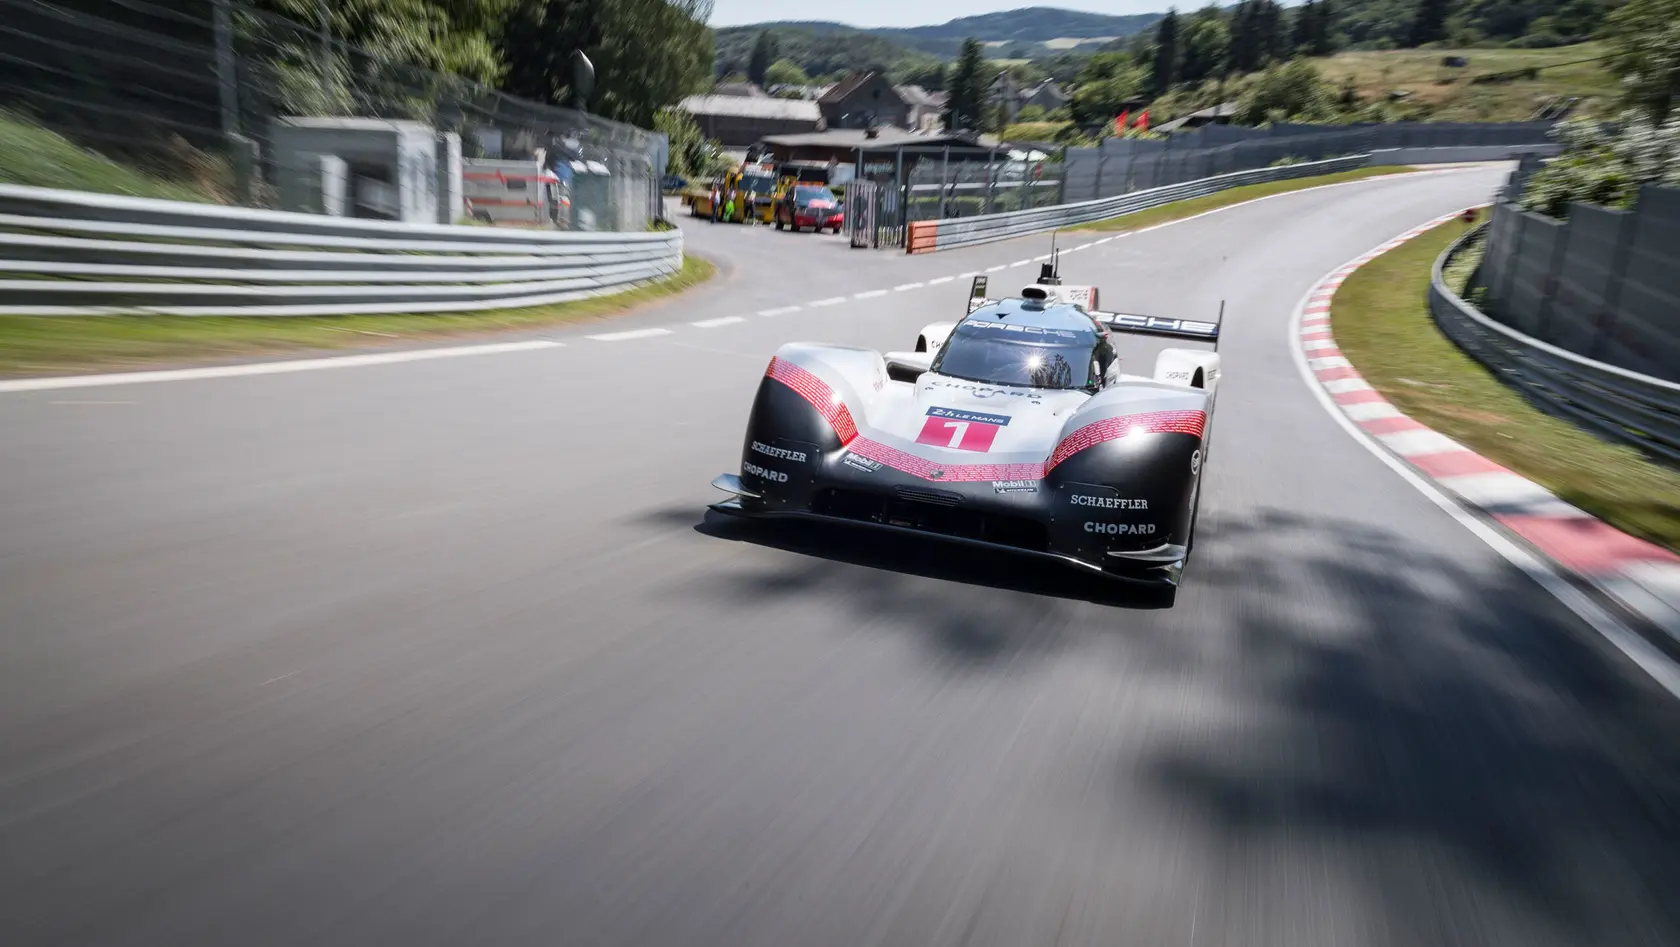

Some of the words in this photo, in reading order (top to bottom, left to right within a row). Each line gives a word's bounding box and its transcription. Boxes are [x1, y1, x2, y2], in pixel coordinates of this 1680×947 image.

[963, 320, 1076, 338] PORSCHE
[931, 381, 1042, 399] CHOPARD
[971, 416, 1005, 424] MANS
[943, 421, 970, 449] 1
[751, 441, 807, 463] SCHAEFFLER
[846, 452, 874, 466] Mobil
[743, 461, 789, 483] CHOPARD
[992, 480, 1025, 488] Mobil
[1070, 494, 1148, 510] SCHAEFFLER
[1083, 521, 1156, 535] CHOPARD
